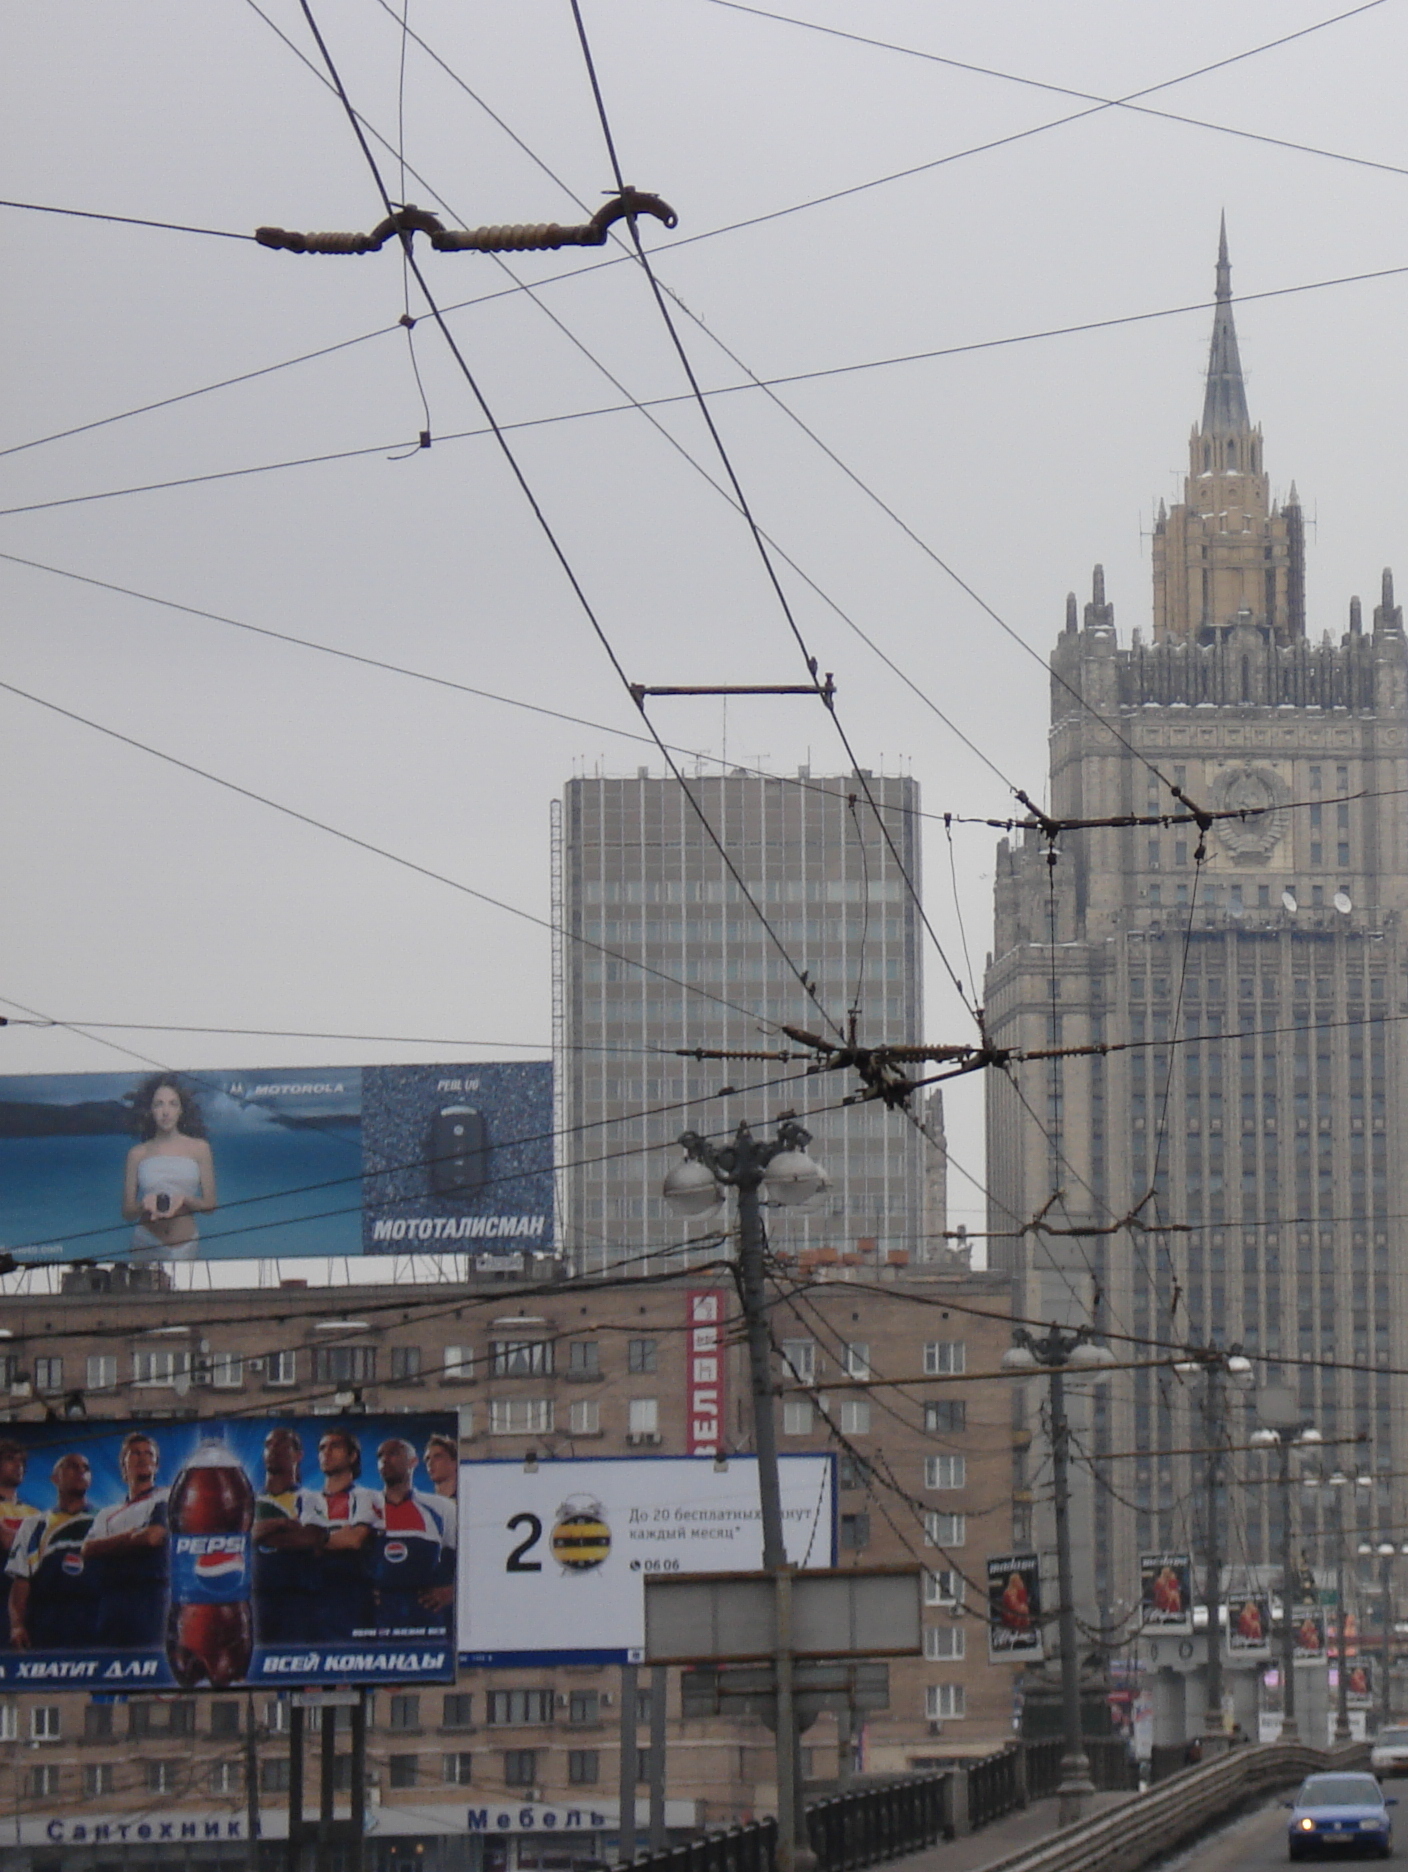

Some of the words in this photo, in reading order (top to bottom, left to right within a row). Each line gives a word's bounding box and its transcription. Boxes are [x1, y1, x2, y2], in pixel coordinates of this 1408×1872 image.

[255, 1082, 345, 1096] MOTOROLA
[373, 1215, 545, 1241] МОТОТАЛИСМАН
[629, 1508, 648, 1524] До
[653, 1509, 671, 1521] 20
[674, 1507, 763, 1521] бесплатных
[629, 1525, 686, 1541] каждый
[176, 1536, 246, 1555] PEPSI
[16, 1660, 98, 1679] ХВАТИТ
[103, 1659, 158, 1678] ДЛЯ
[262, 1652, 321, 1673] ВСЕЙ
[324, 1652, 445, 1672] КОМАНДЫ
[467, 1807, 605, 1831] Мебель
